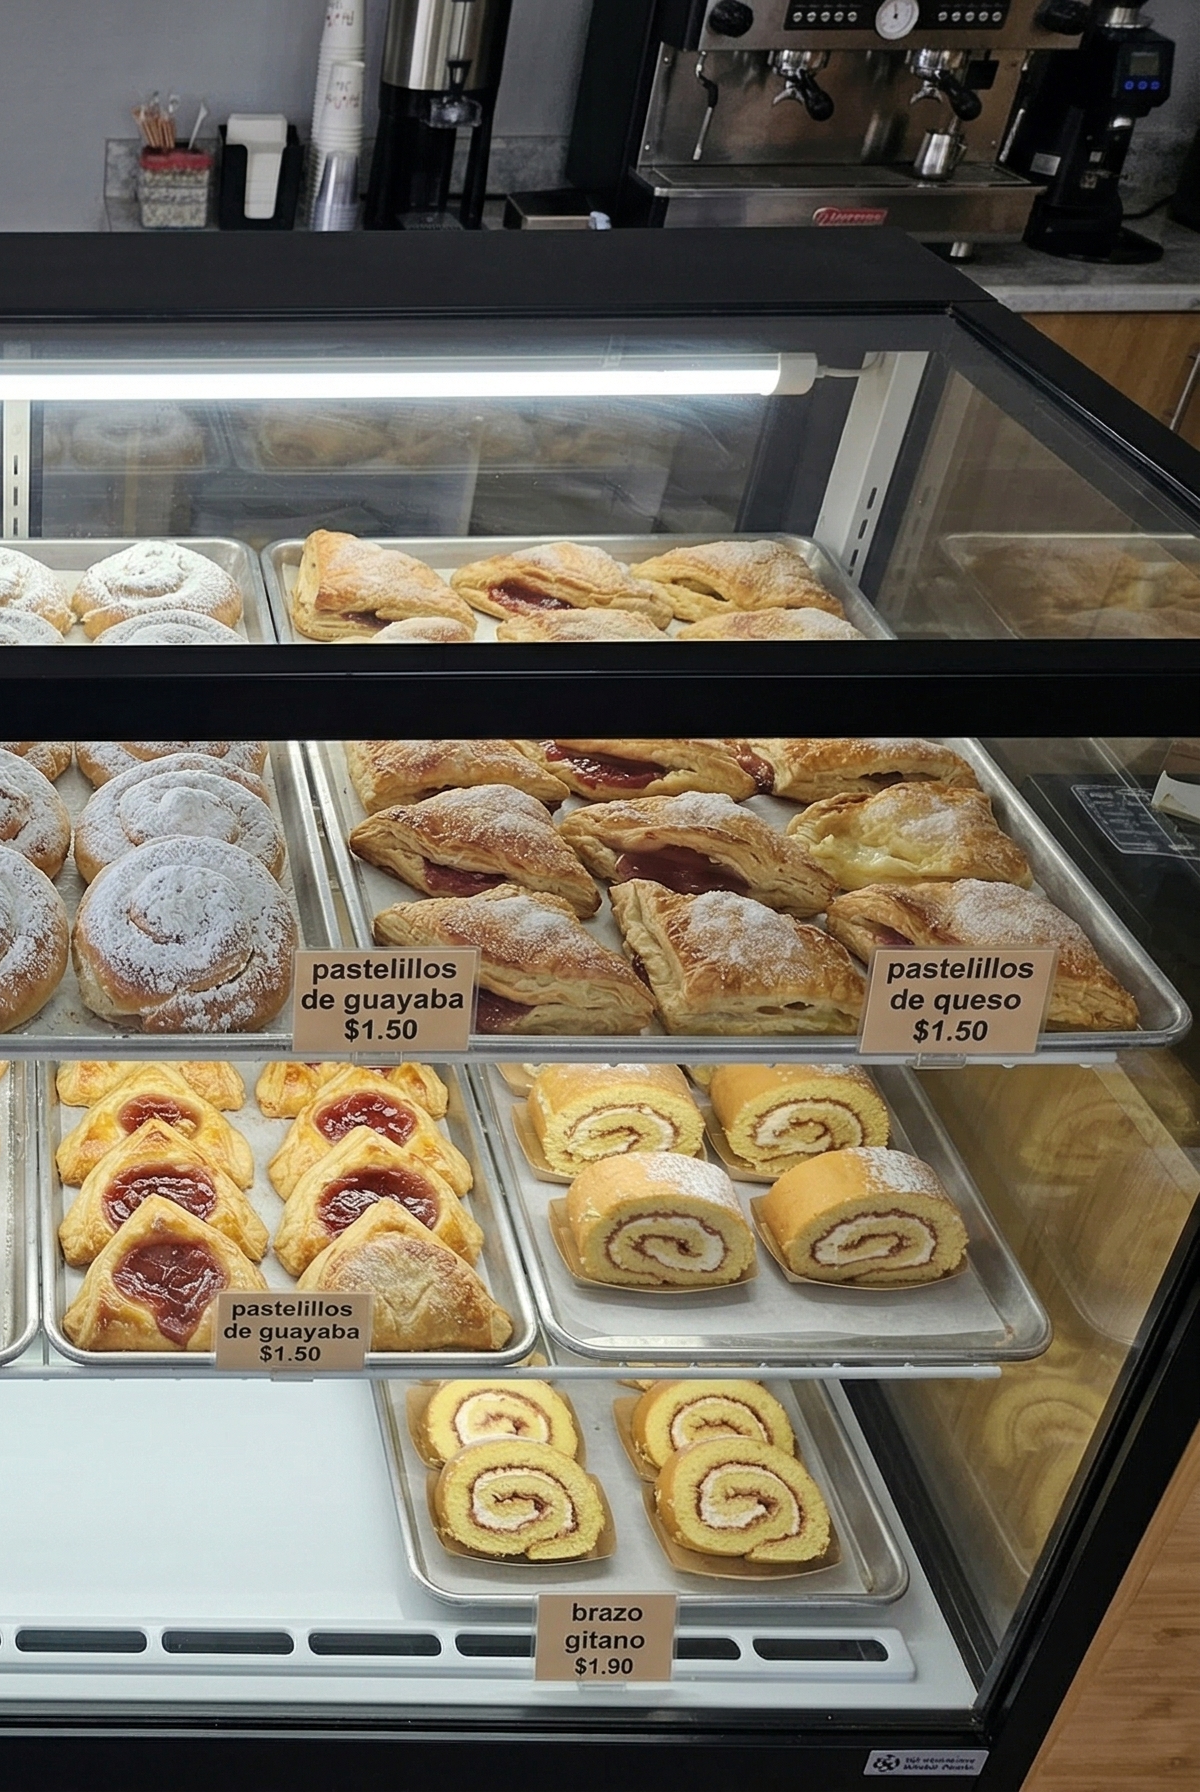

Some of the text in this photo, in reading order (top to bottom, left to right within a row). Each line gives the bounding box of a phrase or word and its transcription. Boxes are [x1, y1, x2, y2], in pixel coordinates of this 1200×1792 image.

[312, 956, 457, 986] pastelillos
[886, 956, 1034, 985] pastelillos
[301, 987, 464, 1015] de guayaba
[890, 988, 1022, 1016] de queso
[344, 1017, 418, 1043] $1.50
[912, 1018, 989, 1044] $1.50
[232, 1299, 353, 1321] pastelillos
[223, 1322, 360, 1343] de guayaba
[259, 1344, 321, 1363] $1.50
[572, 1602, 643, 1622] brazo
[565, 1630, 645, 1654] gitano
[574, 1656, 634, 1676] $1.90
